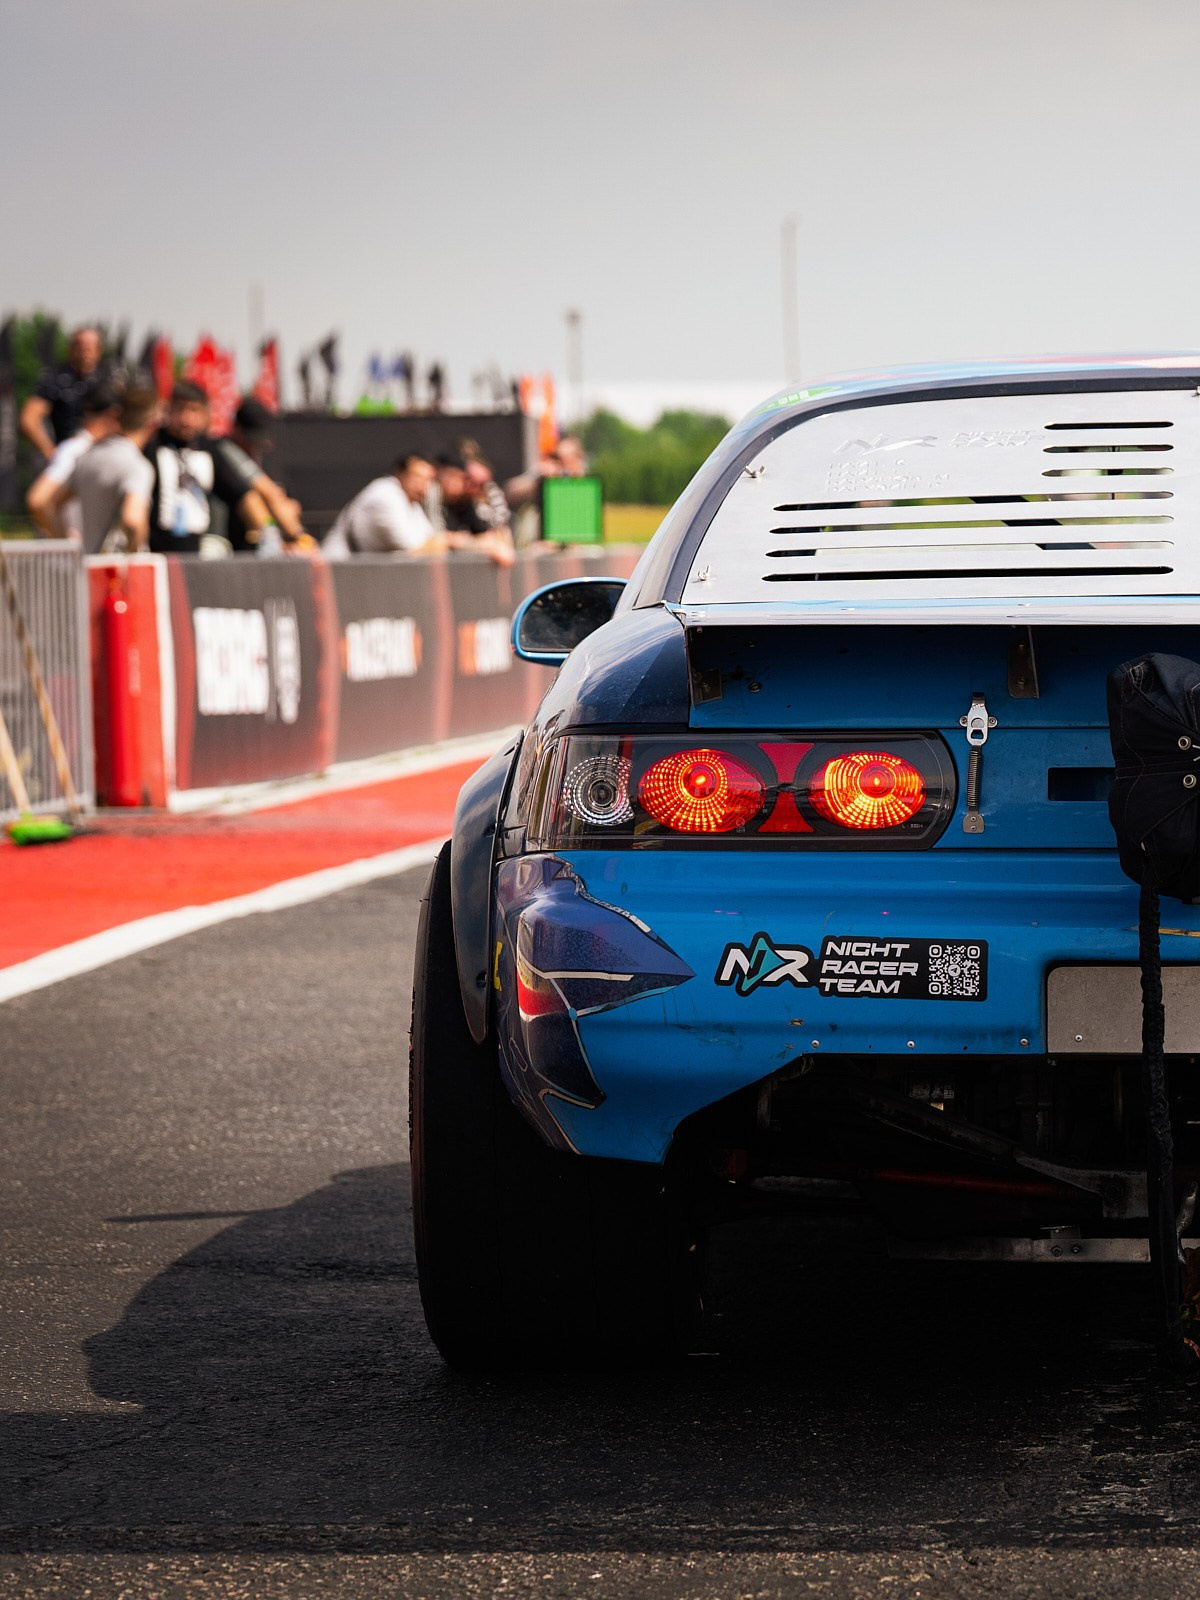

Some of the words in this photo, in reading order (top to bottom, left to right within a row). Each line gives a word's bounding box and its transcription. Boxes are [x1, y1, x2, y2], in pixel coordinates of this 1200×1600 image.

[825, 941, 910, 958] NIGHT
[821, 960, 919, 977] RACER
[819, 978, 901, 994] TEAM
